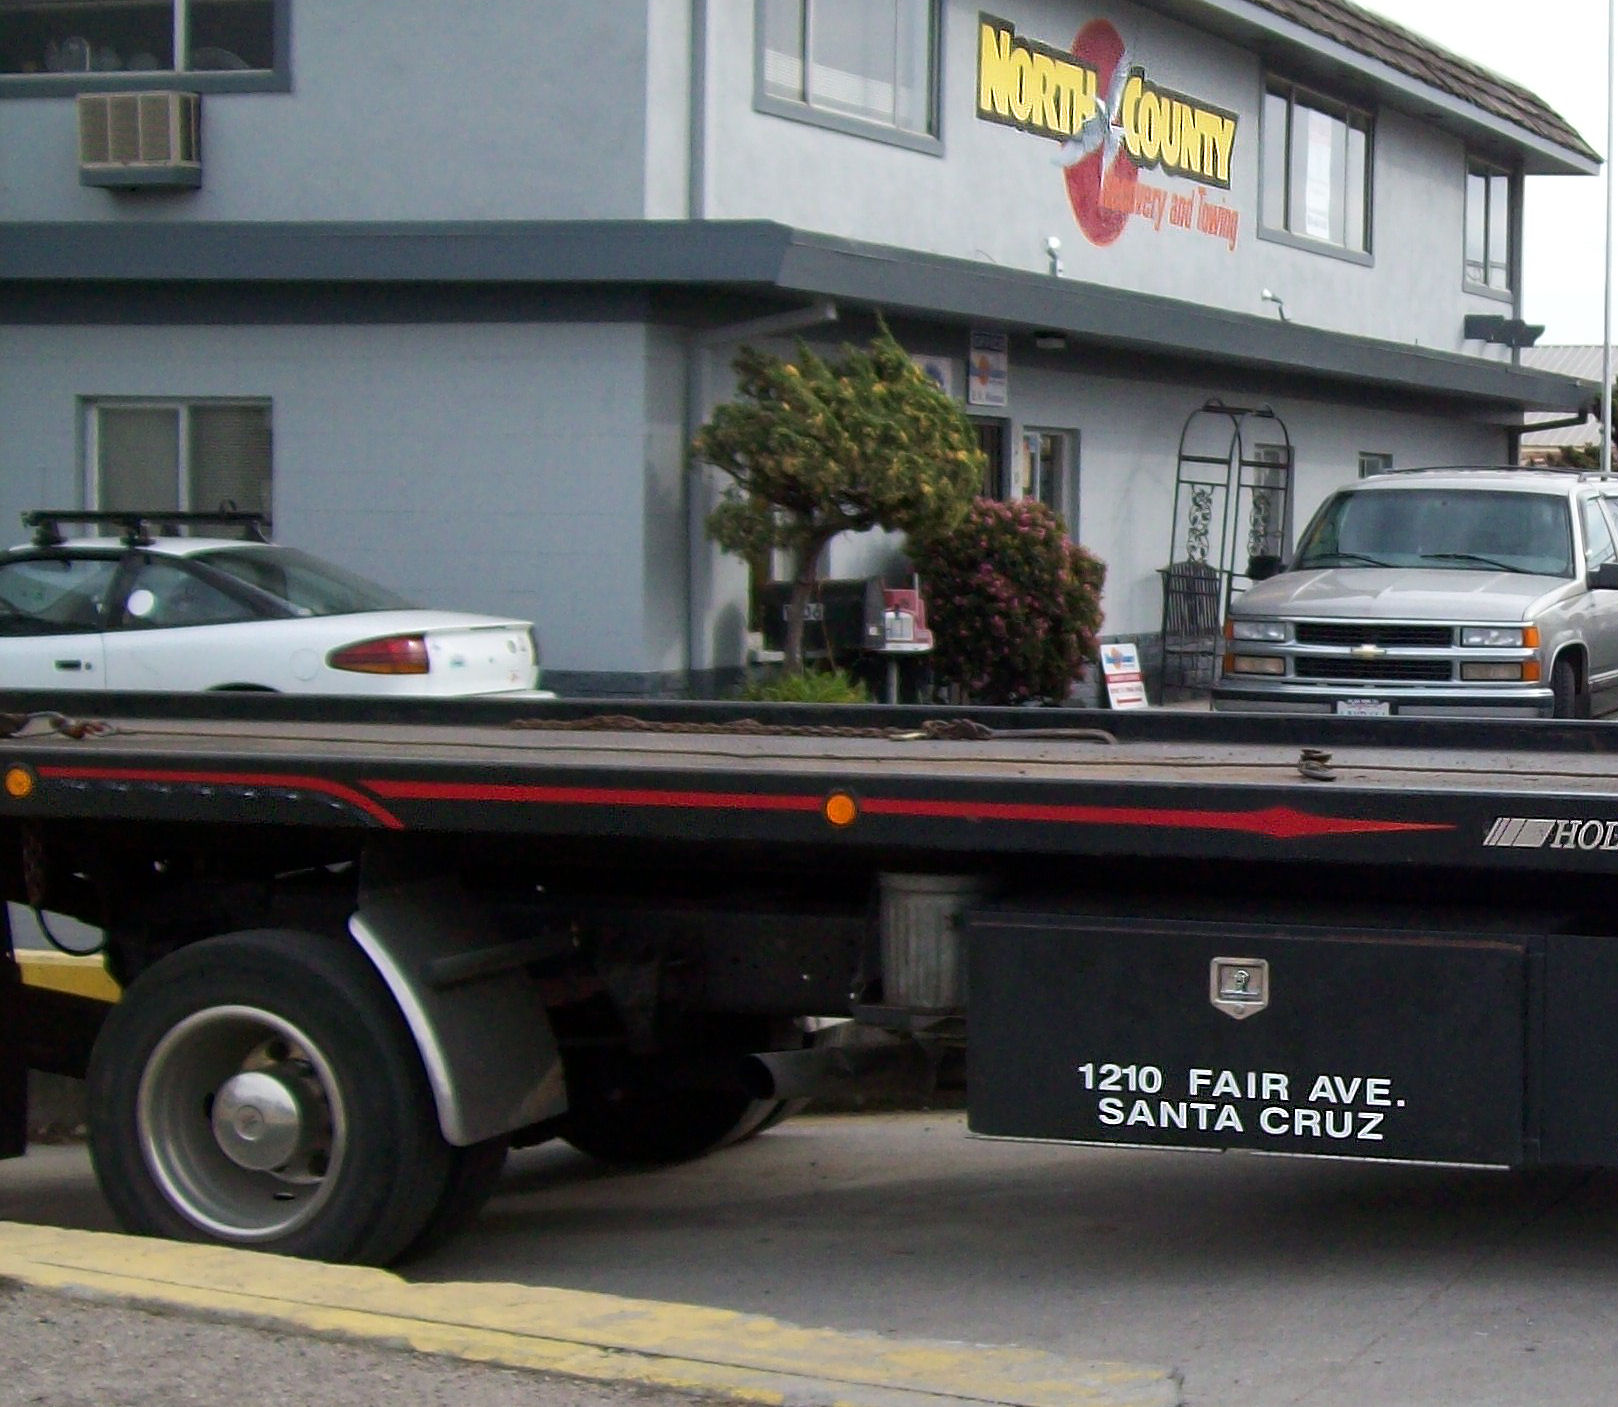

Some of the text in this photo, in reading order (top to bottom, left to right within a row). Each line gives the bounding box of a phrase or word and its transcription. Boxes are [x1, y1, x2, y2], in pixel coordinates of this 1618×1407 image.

[979, 22, 1236, 182] NORTH COUNTY
[1102, 172, 1168, 233] very
[1078, 1062, 1407, 1107] 1210 FAIR AVE.
[1099, 1098, 1385, 1141] SANTA CRUZ
